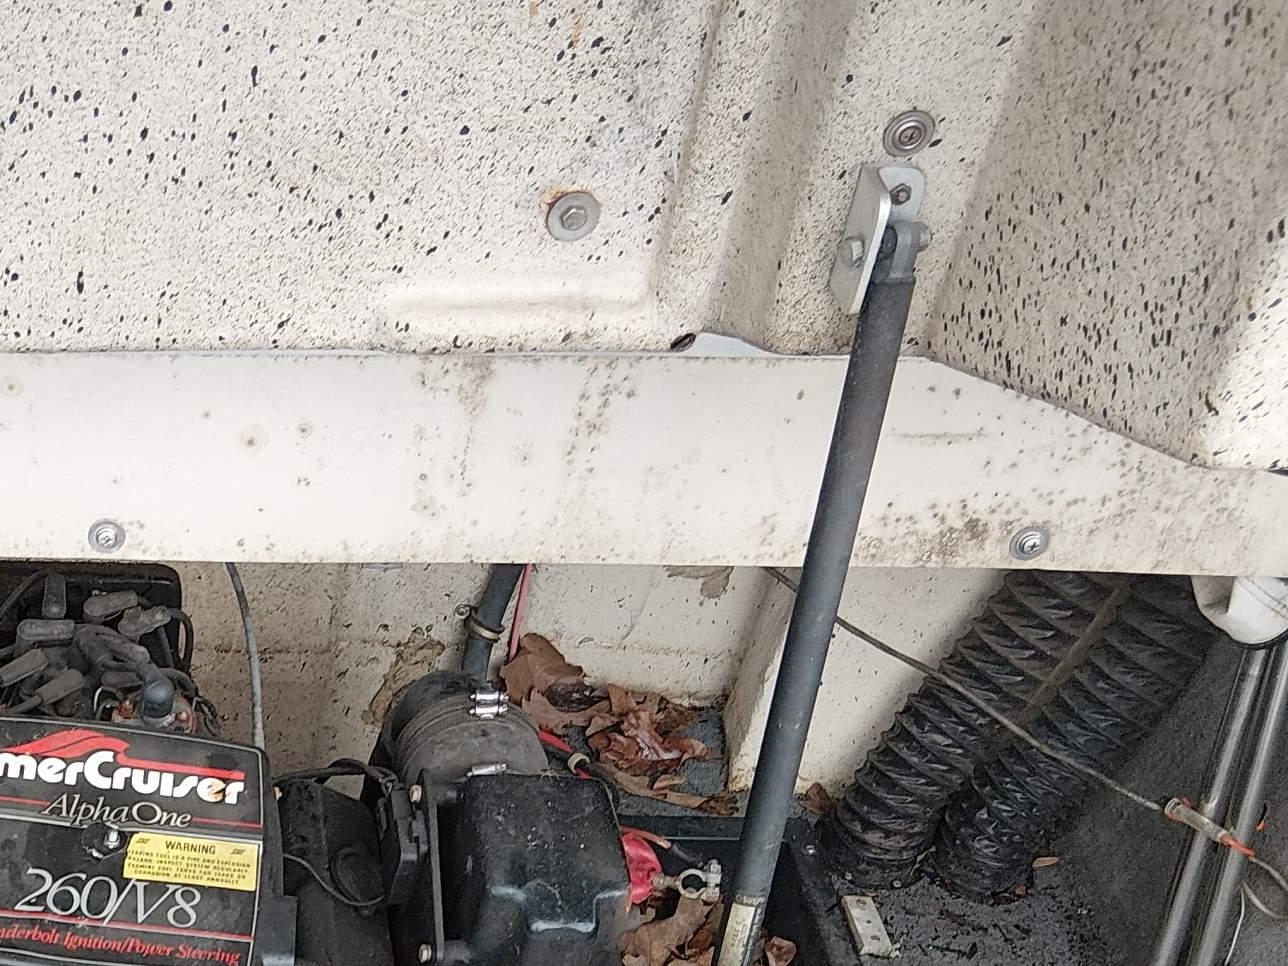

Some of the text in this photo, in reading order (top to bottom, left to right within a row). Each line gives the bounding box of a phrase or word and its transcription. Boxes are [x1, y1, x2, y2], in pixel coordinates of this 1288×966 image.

[165, 840, 216, 855] WARNING
[14, 866, 201, 928] 260/V8
[175, 943, 241, 966] Steering
